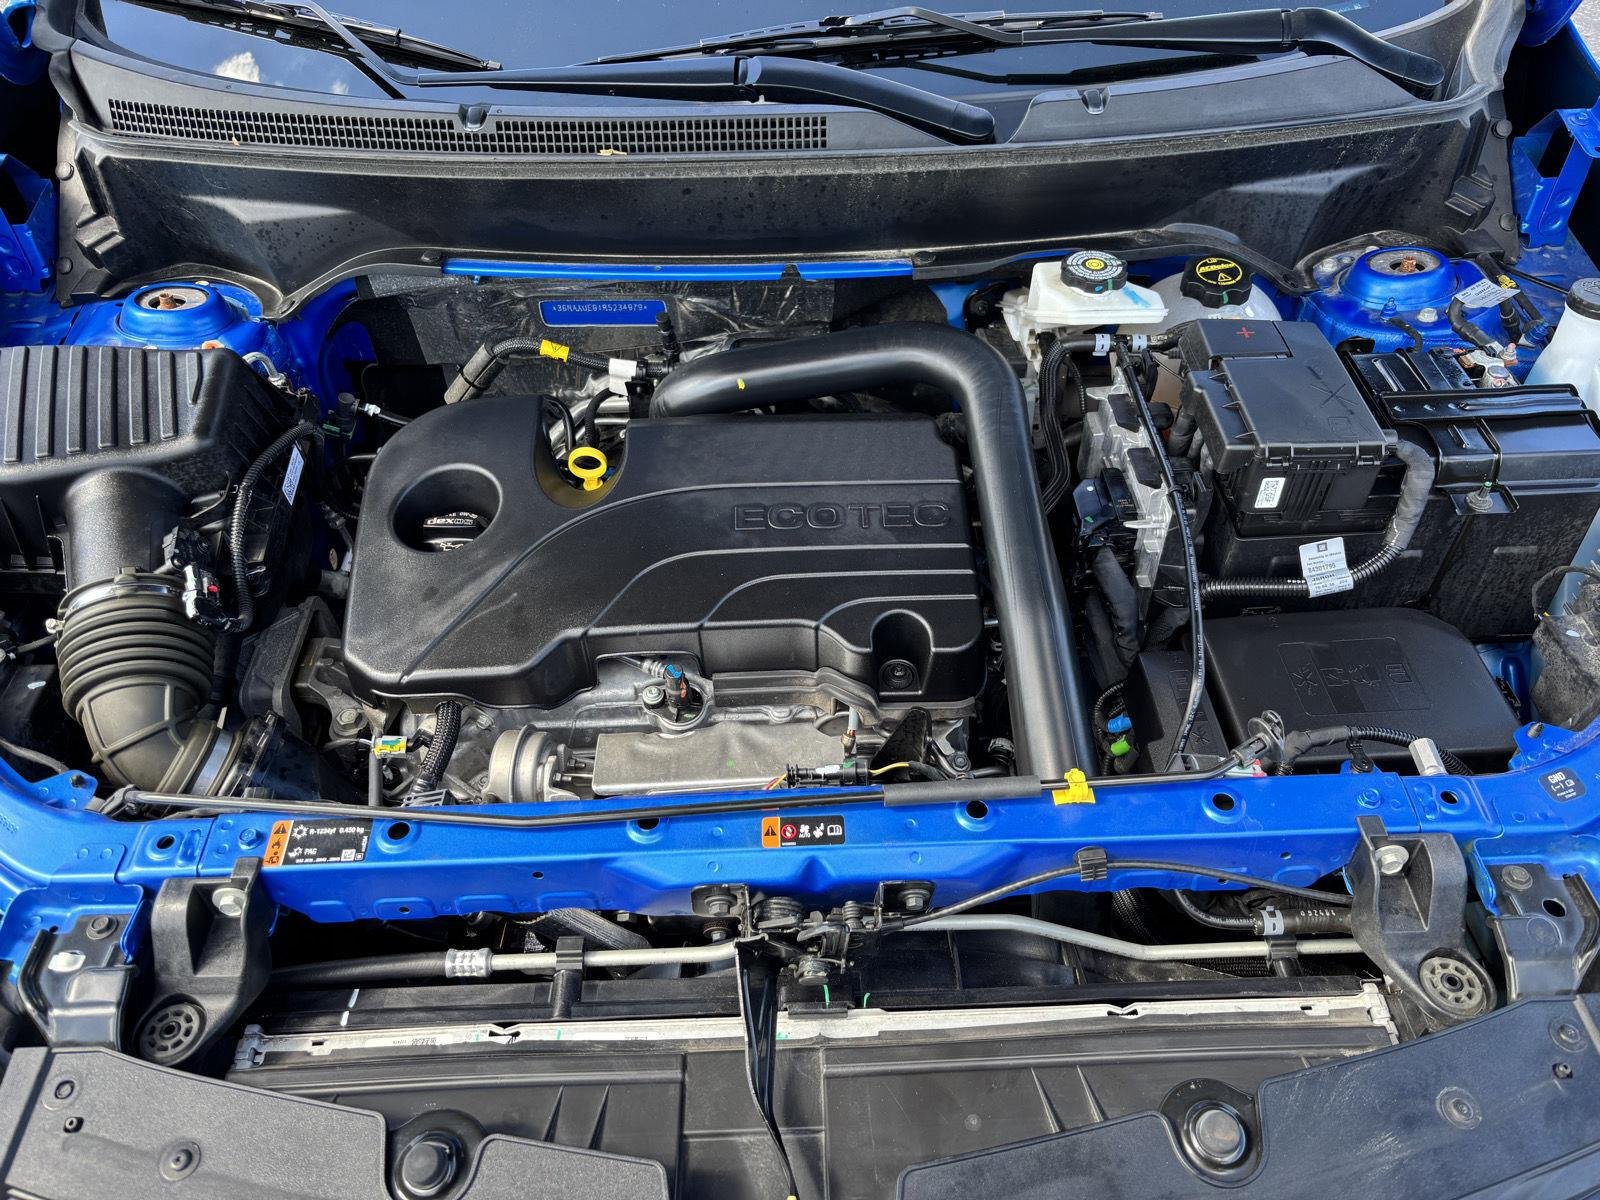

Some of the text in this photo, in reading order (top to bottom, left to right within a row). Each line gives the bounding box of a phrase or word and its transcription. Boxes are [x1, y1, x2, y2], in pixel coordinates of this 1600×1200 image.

[734, 503, 949, 531] ECOTEC
[1548, 772, 1565, 783] GND
[309, 825, 365, 836] R-1234yf 0.450 kg
[304, 847, 317, 856] PAG
